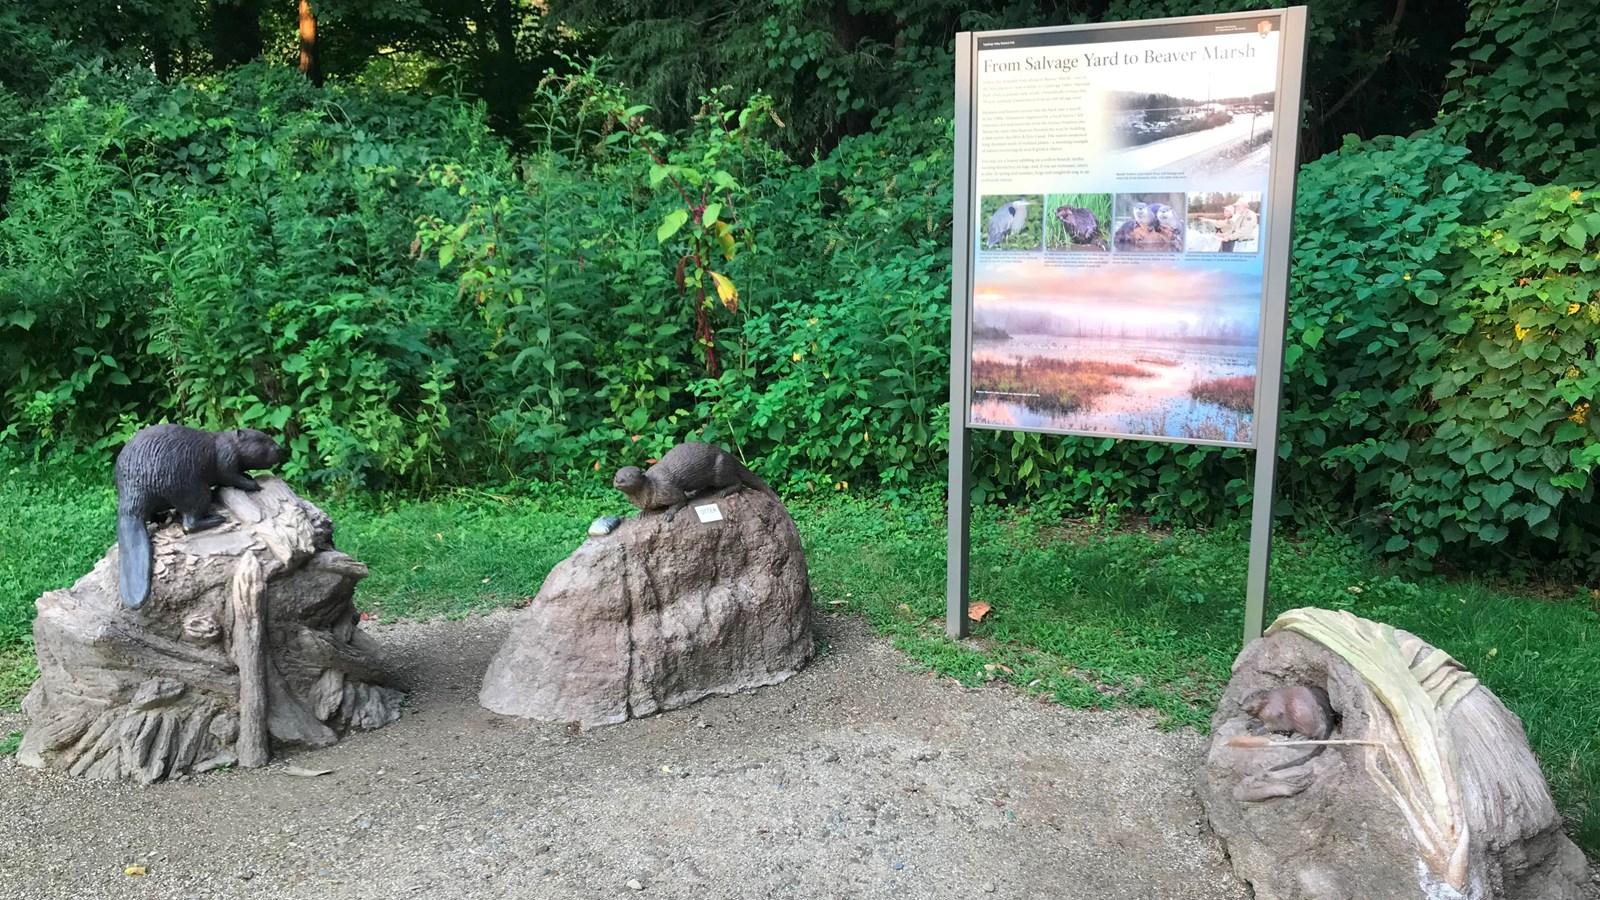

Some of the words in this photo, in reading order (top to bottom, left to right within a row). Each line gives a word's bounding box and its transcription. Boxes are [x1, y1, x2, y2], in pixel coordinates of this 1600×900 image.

[984, 59, 1021, 73] From
[1025, 55, 1079, 73] Salvage
[1084, 51, 1119, 68] Yard
[1124, 53, 1139, 65] to
[1144, 49, 1197, 64] Beaver
[1203, 42, 1256, 60] Marsh
